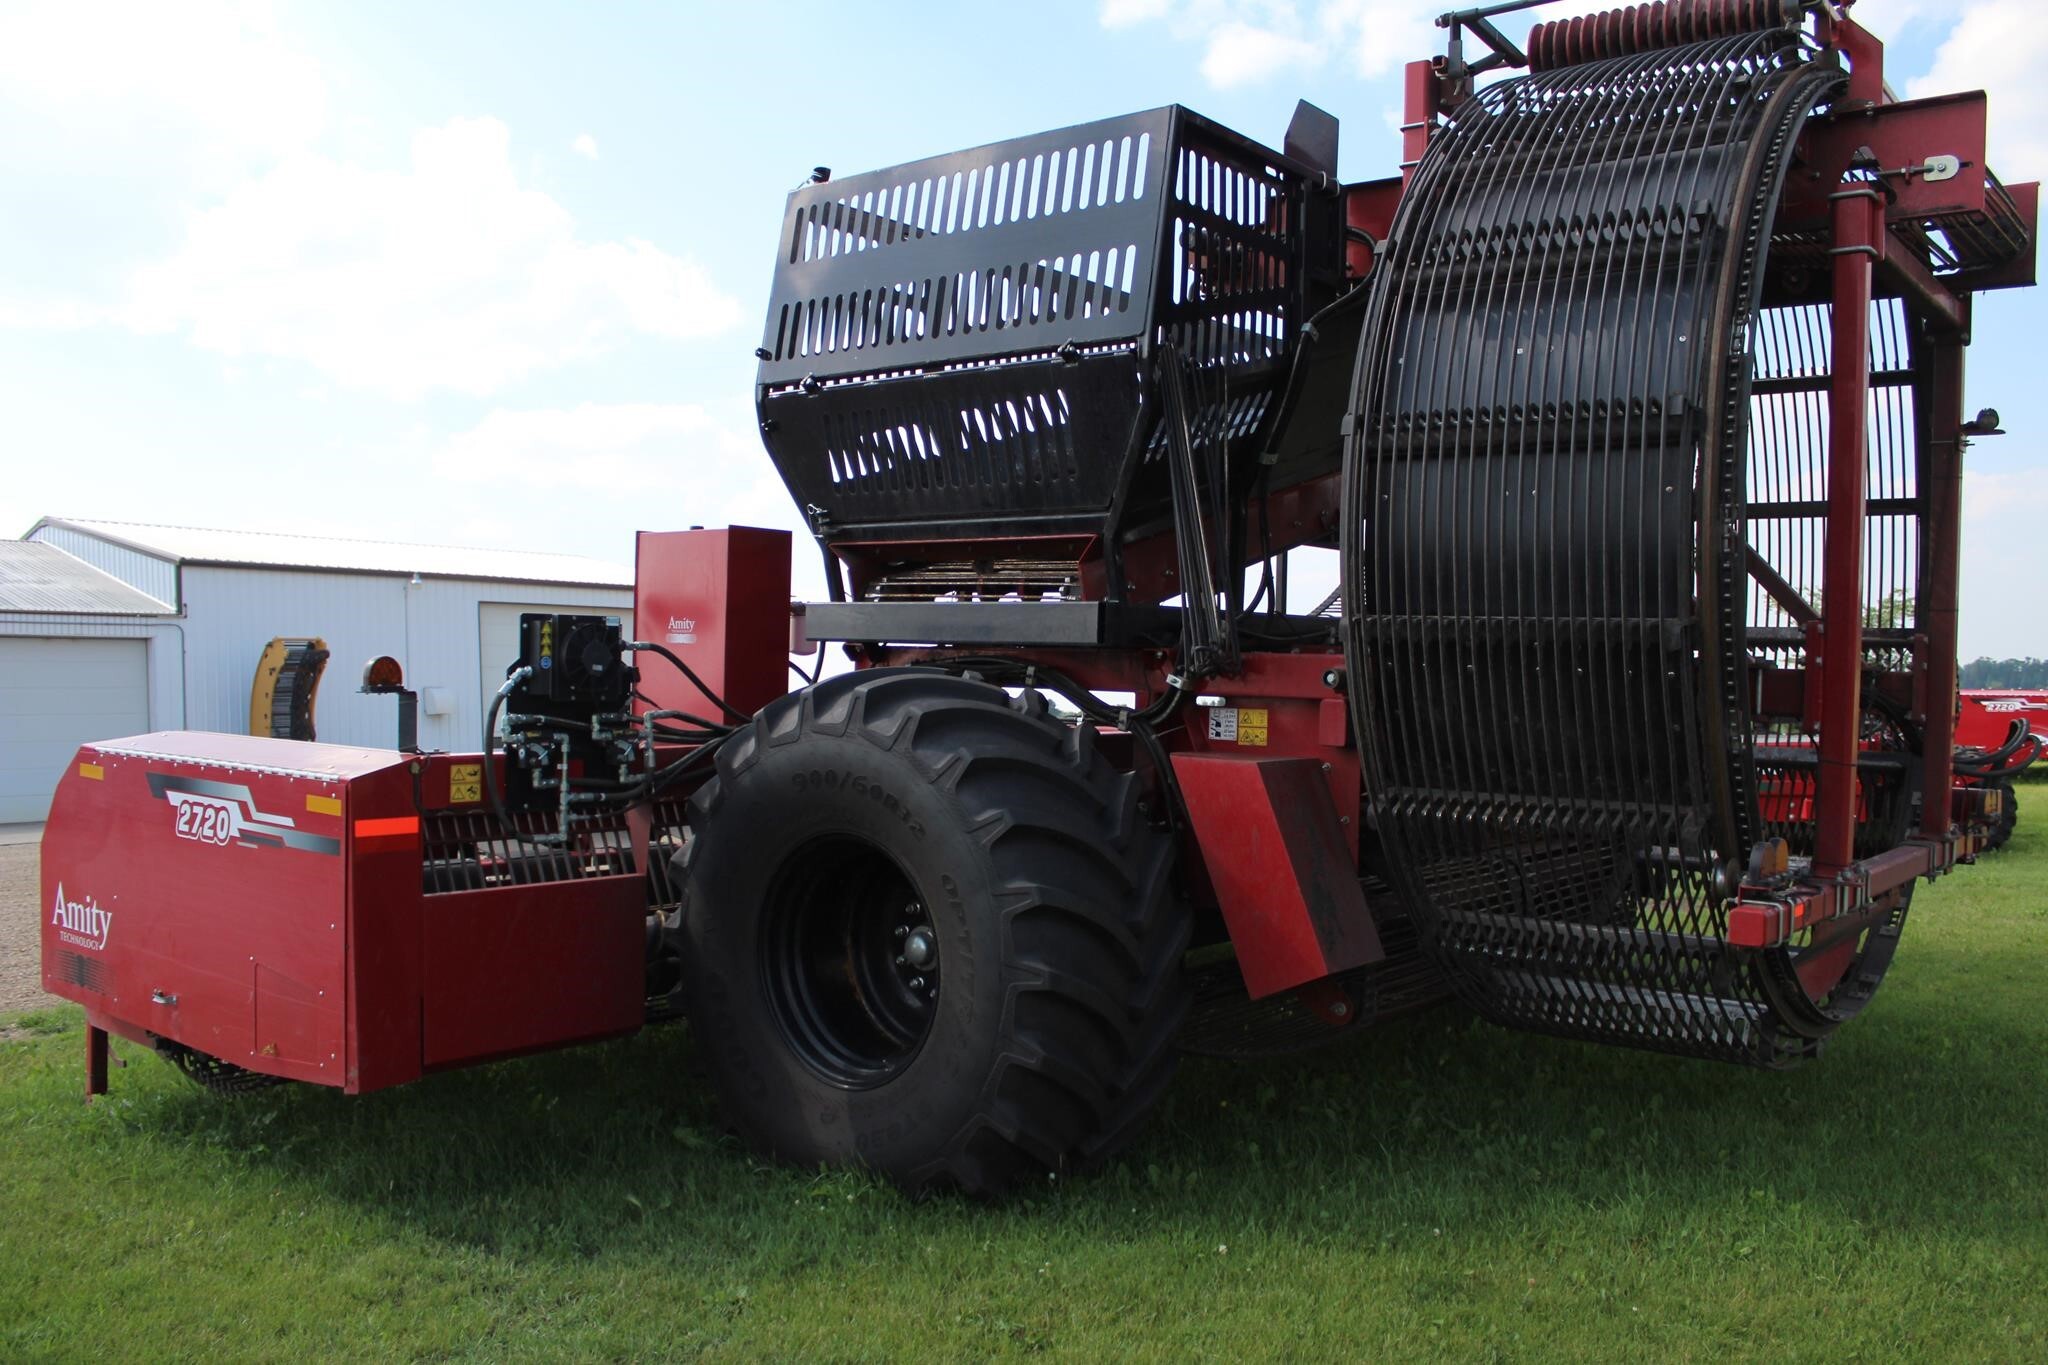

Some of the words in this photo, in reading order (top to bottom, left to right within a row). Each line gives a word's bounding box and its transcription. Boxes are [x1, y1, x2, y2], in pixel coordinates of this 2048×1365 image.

[668, 615, 696, 633] Amity
[1986, 703, 2015, 712] 2720
[177, 802, 230, 841] 2720
[52, 880, 113, 950] Amity
[60, 930, 99, 950] TECHNOLOGY
